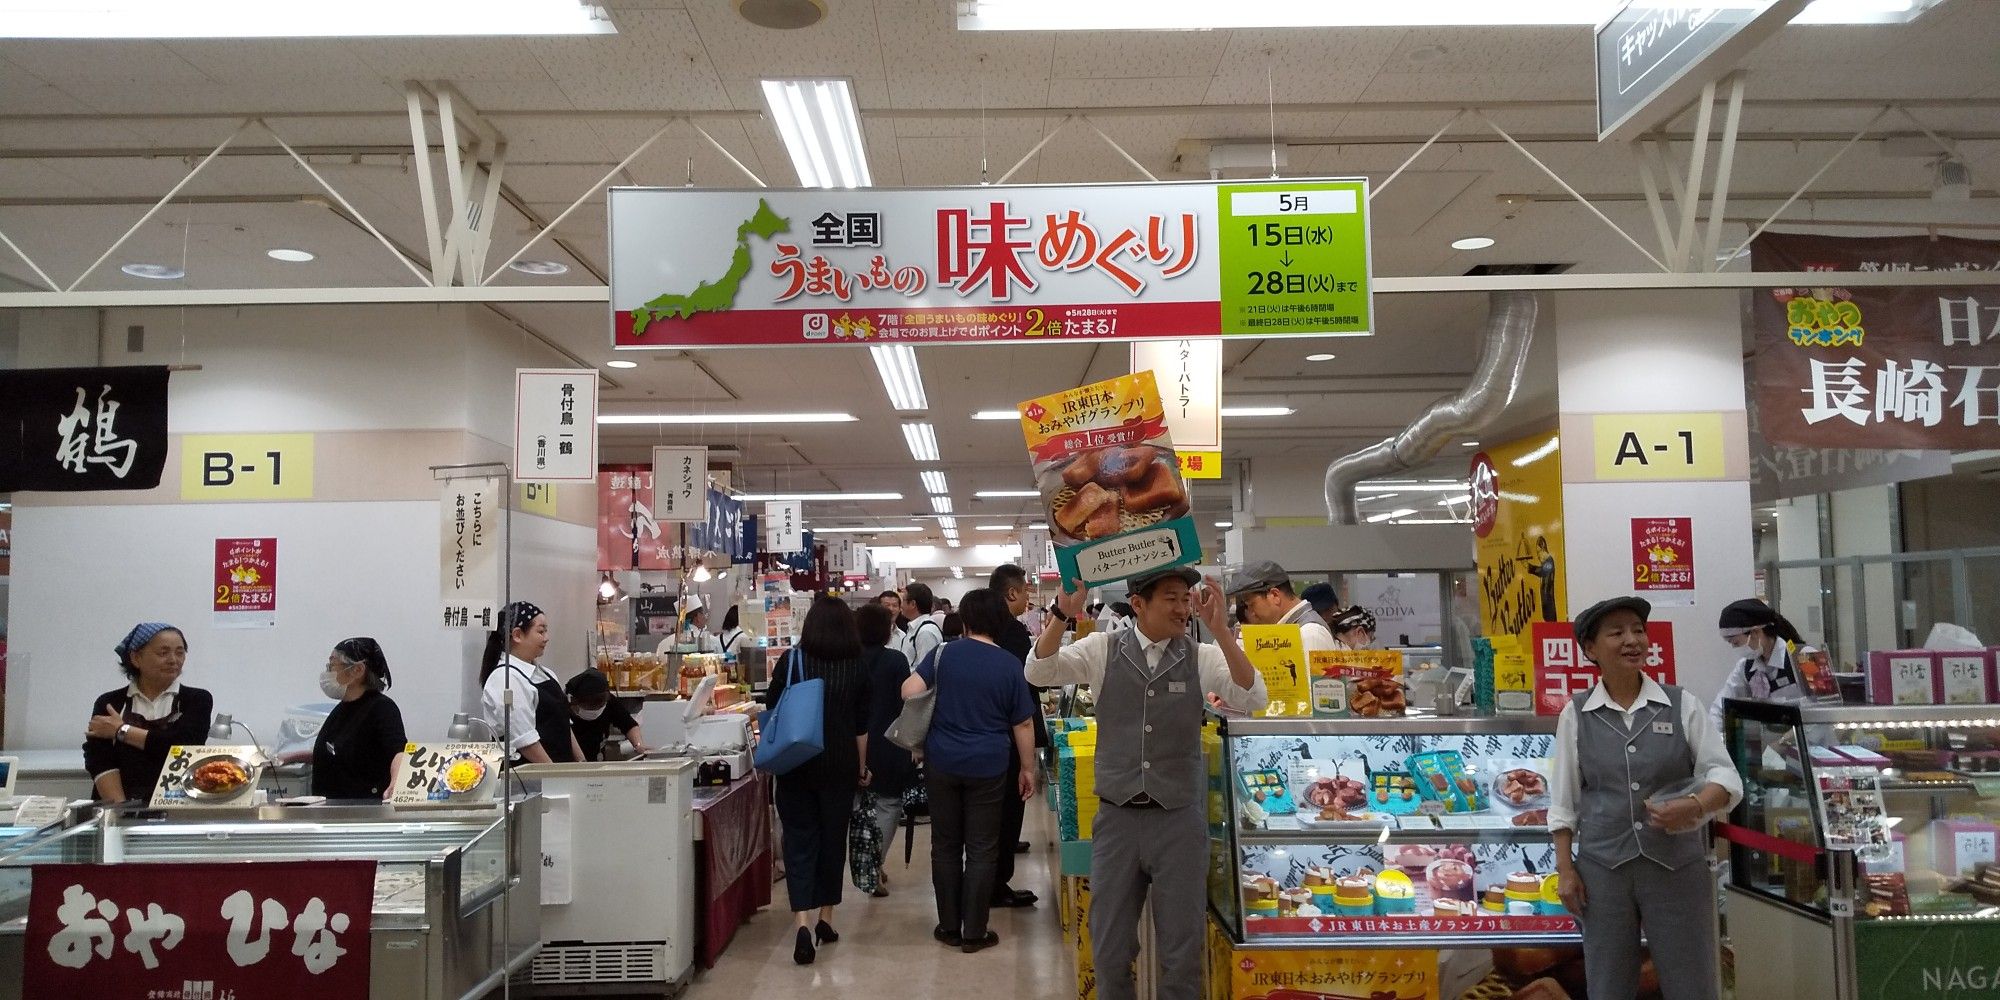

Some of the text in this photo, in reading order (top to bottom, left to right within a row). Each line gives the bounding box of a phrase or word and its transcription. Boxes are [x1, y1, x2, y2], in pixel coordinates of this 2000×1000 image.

[1279, 194, 1309, 213] 5月
[812, 212, 878, 245] 全国
[1247, 222, 1333, 247] 15日(水)
[936, 202, 1198, 298] 味めぐり
[770, 243, 926, 301] うまいもの
[1247, 270, 1359, 296] 28日(火)まで
[1788, 298, 1861, 327] おやつ
[1939, 296, 2000, 346] 日
[558, 383, 575, 455] 骨付鳥 一鶴
[1038, 396, 1145, 435] おみやげグランプリ
[1062, 389, 1114, 415] JR東日本
[56, 384, 137, 479] 鶴
[1614, 431, 1694, 465] A-1
[203, 451, 281, 486] B-1
[682, 455, 693, 499] カネショウ
[473, 491, 482, 547] こちらに
[455, 493, 465, 590] お並びください
[1097, 538, 1157, 560] Butter Butler
[1092, 549, 1169, 574] バターフィナンシェ
[444, 606, 491, 628] 骨付鳥 一鶴
[48, 884, 351, 975] おや ひな
[1251, 971, 1427, 986] JR東日本おみやげグランプリ
